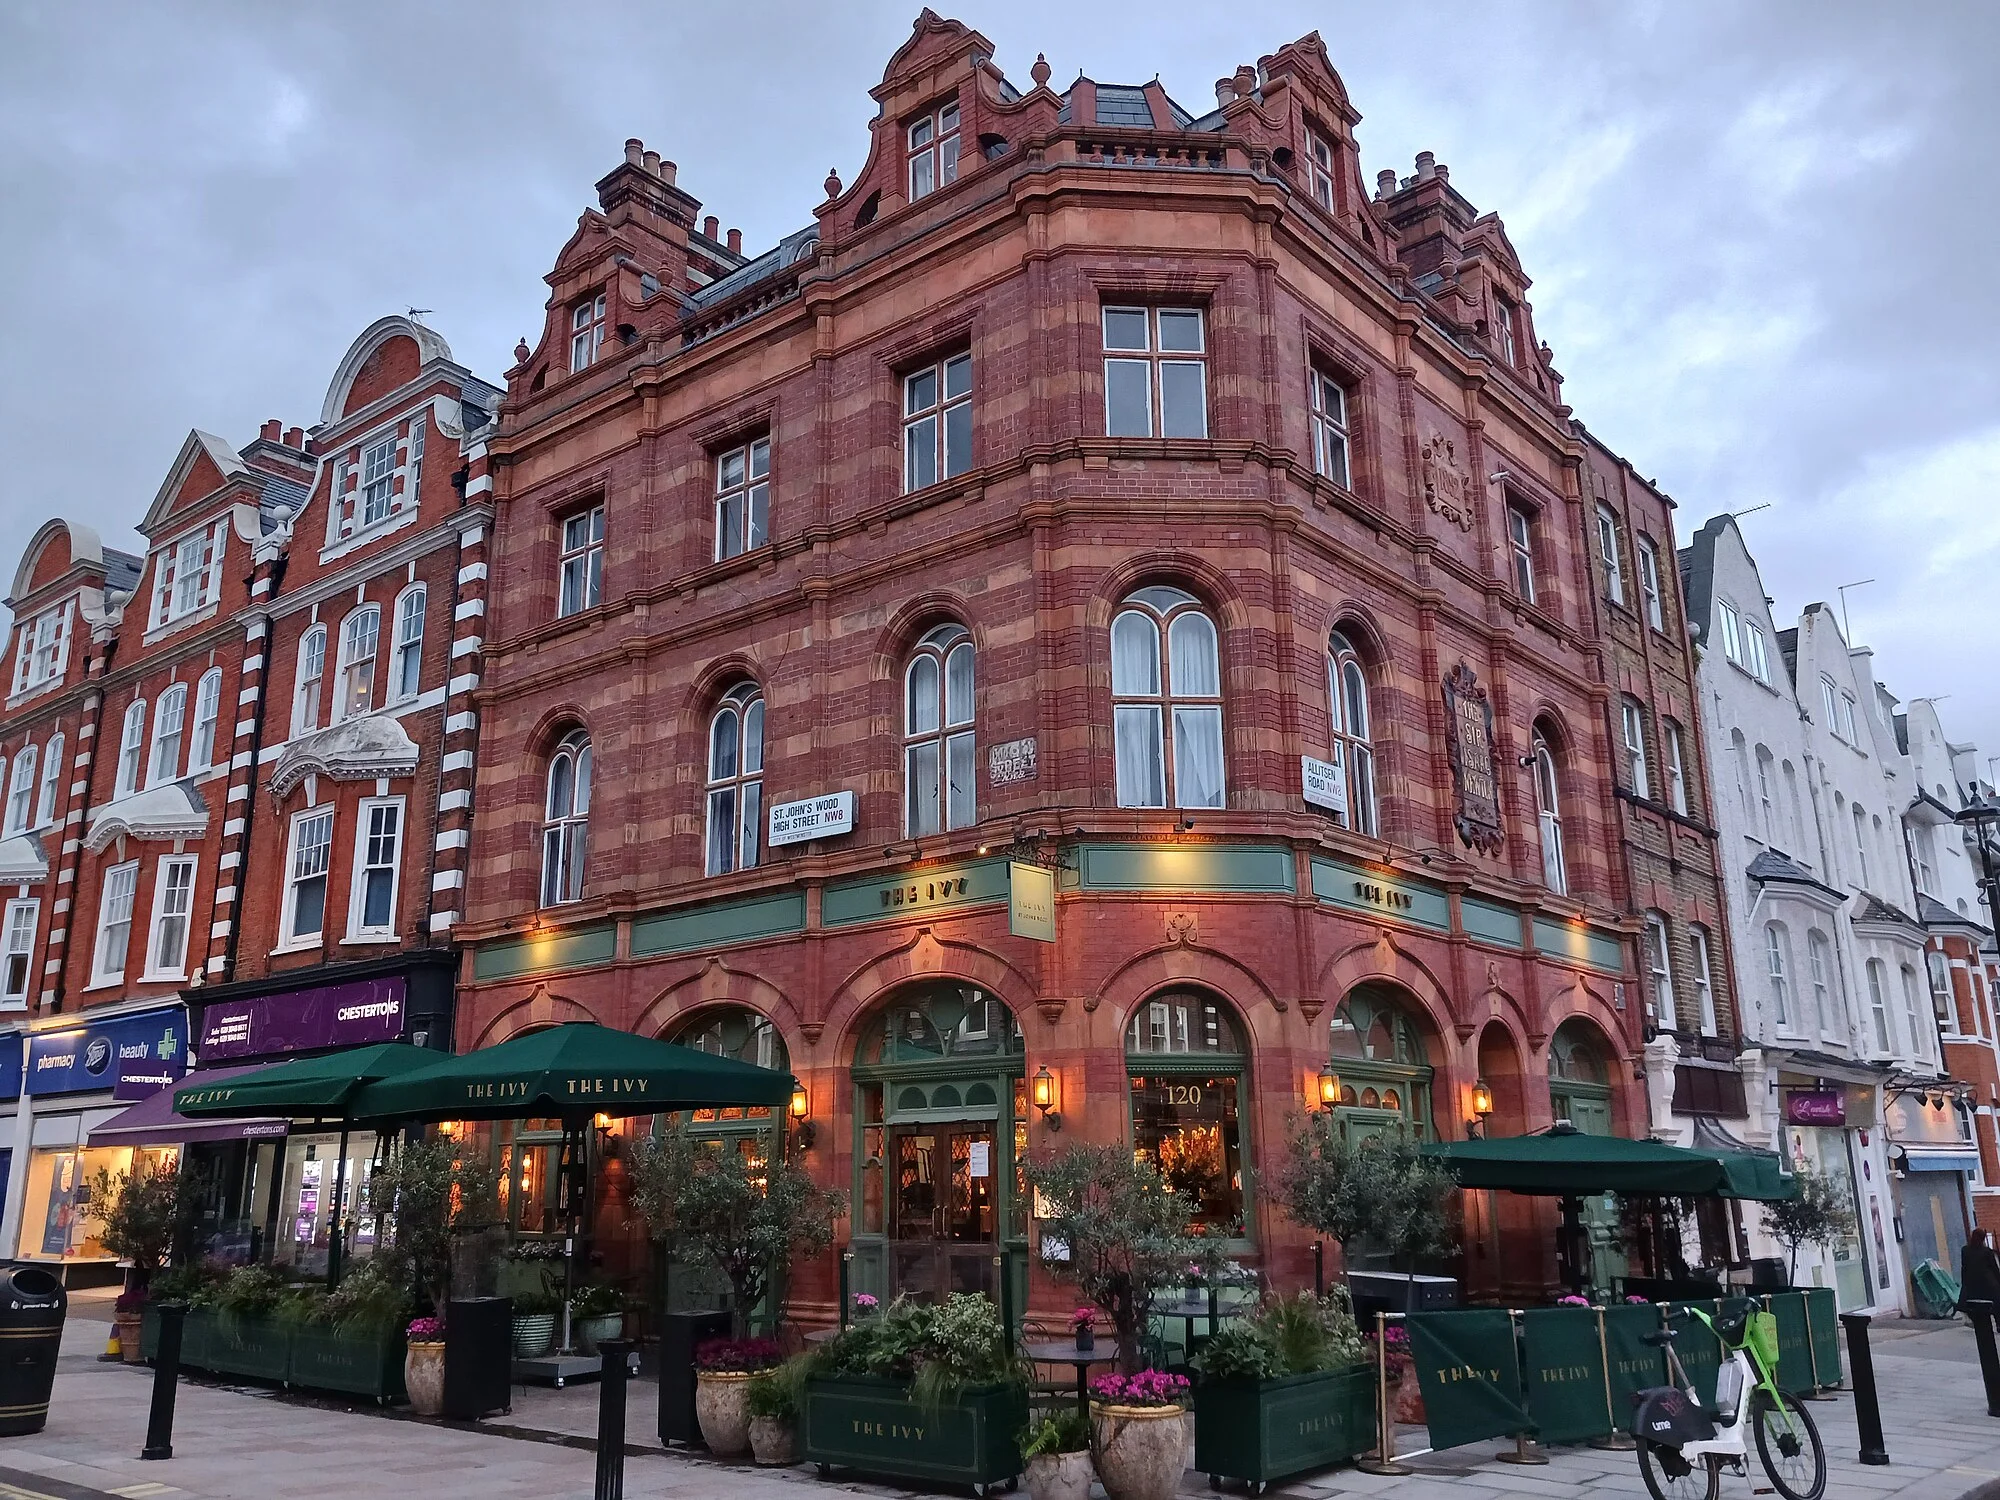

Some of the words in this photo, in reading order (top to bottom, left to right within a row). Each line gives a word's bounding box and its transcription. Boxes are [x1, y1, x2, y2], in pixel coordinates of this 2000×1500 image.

[1308, 762, 1336, 781] ALLITSEN
[1308, 775, 1325, 790] ROAD
[786, 803, 812, 818] JOHN'S
[815, 798, 838, 811] WOOD
[773, 820, 790, 833] HIGH
[792, 814, 820, 828] STREET
[824, 810, 843, 822] NW8
[880, 886, 918, 908] THE
[925, 877, 969, 901] IVY
[1353, 882, 1383, 904] THE
[1386, 890, 1413, 909] IVY
[337, 1001, 399, 1021] CHESTERTONS
[119, 1042, 149, 1059] beauty
[37, 1054, 75, 1072] pharmacy
[121, 1075, 173, 1084] CHESTERTONS
[567, 1079, 604, 1093] THE
[612, 1078, 648, 1092] IVY
[179, 1093, 205, 1105] THE
[207, 1090, 235, 1102] IVY
[467, 1083, 493, 1097] THE
[500, 1082, 529, 1096] IVY
[1166, 1086, 1201, 1104] 120
[243, 1125, 285, 1135] chestertons.com
[1437, 1365, 1476, 1384] THE
[1541, 1368, 1565, 1382] THE
[1569, 1366, 1589, 1380] IVY
[853, 1420, 884, 1436] THE
[892, 1424, 924, 1440] IVY
